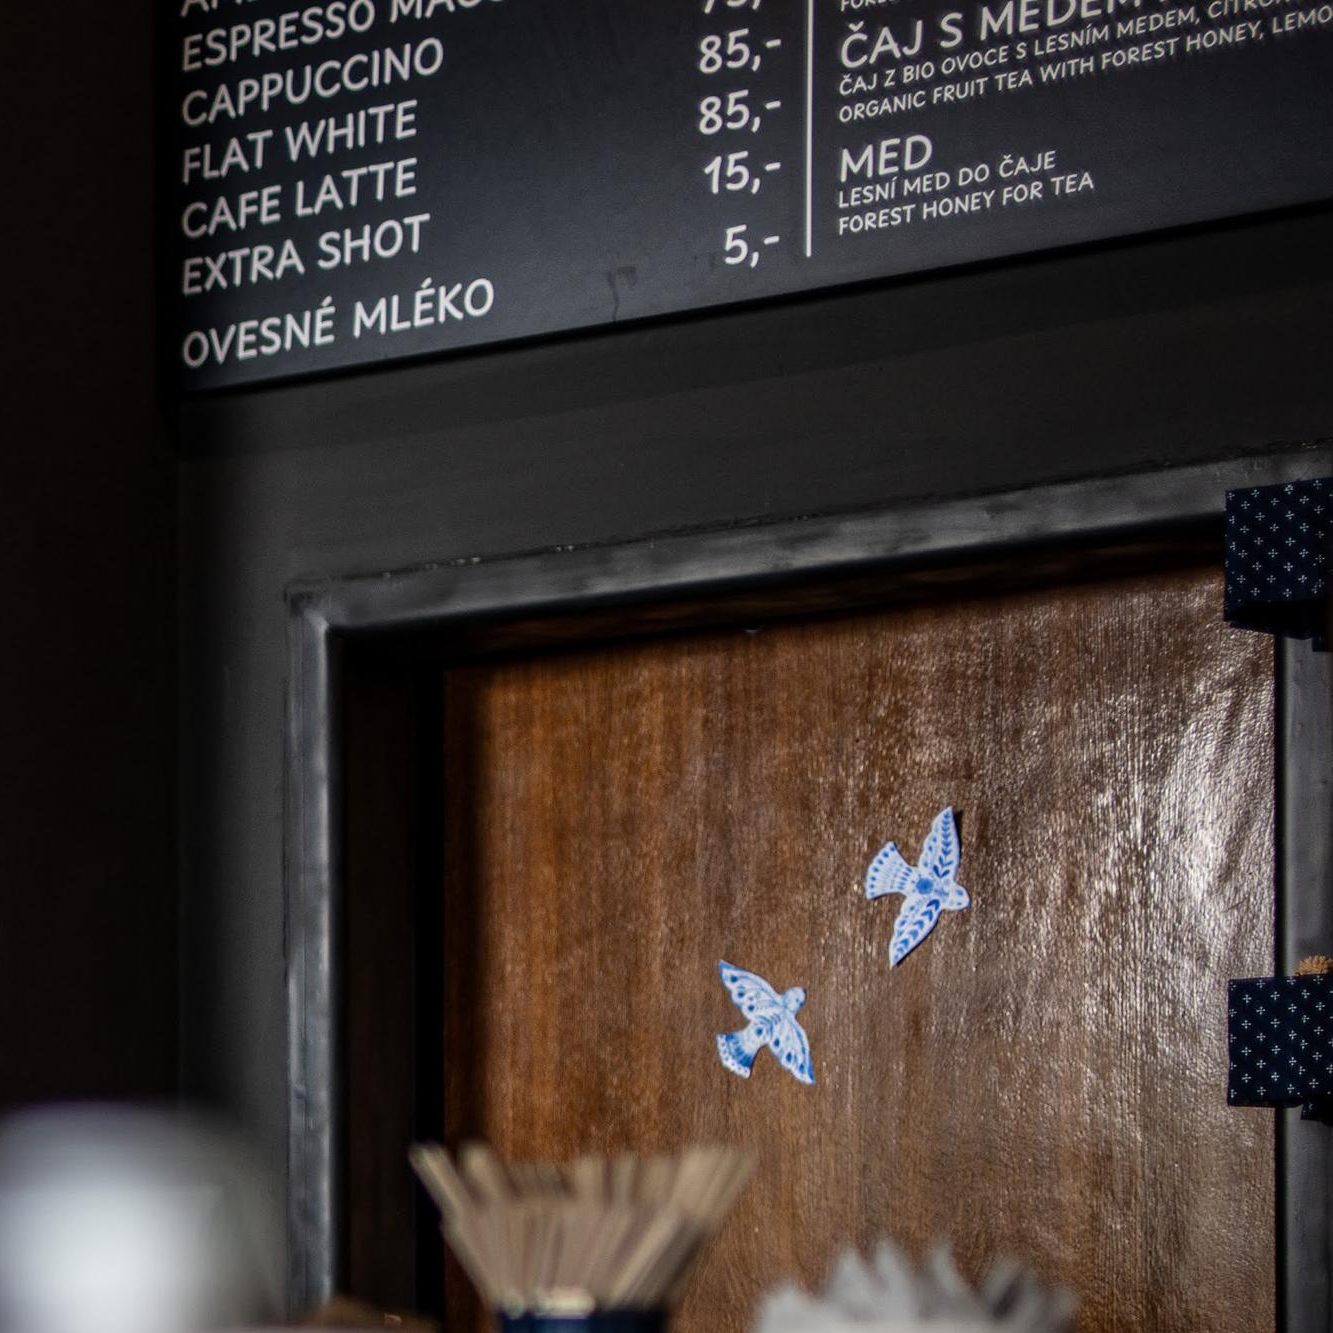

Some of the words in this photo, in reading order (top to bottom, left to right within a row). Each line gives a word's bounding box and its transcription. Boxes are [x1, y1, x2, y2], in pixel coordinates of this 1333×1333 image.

[182, 0, 375, 71] ESPRESSO
[699, 28, 782, 74] 85,-
[839, 74, 877, 96] ČAJ
[884, 69, 896, 88] Z
[903, 61, 935, 84] BIO
[941, 45, 1009, 75] OVOCE
[1016, 42, 1027, 60] S
[1034, 24, 1109, 57] LESNÍM
[1116, 6, 1200, 39] MEDEM,
[841, 21, 923, 68] ČAJ
[940, 12, 964, 48] S
[183, 37, 443, 126] CAPPUCCINO
[839, 90, 926, 123] ORGANIC
[933, 77, 988, 104] FRUIT
[995, 69, 1033, 92] TEA
[1040, 56, 1094, 83] WITH
[1101, 37, 1179, 70] FOREST
[1186, 20, 1264, 52] HONEY,
[183, 129, 273, 184] FLAT
[285, 99, 418, 161] WHITE
[699, 89, 781, 134] 85,-
[704, 150, 781, 195] 15,-
[838, 176, 897, 208] LESNÍ
[903, 172, 950, 196] MED
[958, 164, 990, 186] DO
[998, 150, 1056, 178] ČAJE
[840, 134, 933, 183] MED
[183, 184, 282, 238] CAFE
[295, 157, 418, 217] LATTE
[839, 204, 916, 235] FOREST
[923, 190, 995, 220] HONEY
[1002, 182, 1043, 206] FOR
[1051, 172, 1094, 195] TEA
[183, 238, 305, 295] EXTRA
[317, 213, 430, 269] SHOT
[724, 224, 780, 268] 5,-
[183, 295, 336, 367] OVESNÉ
[353, 277, 494, 339] MLÉKO
